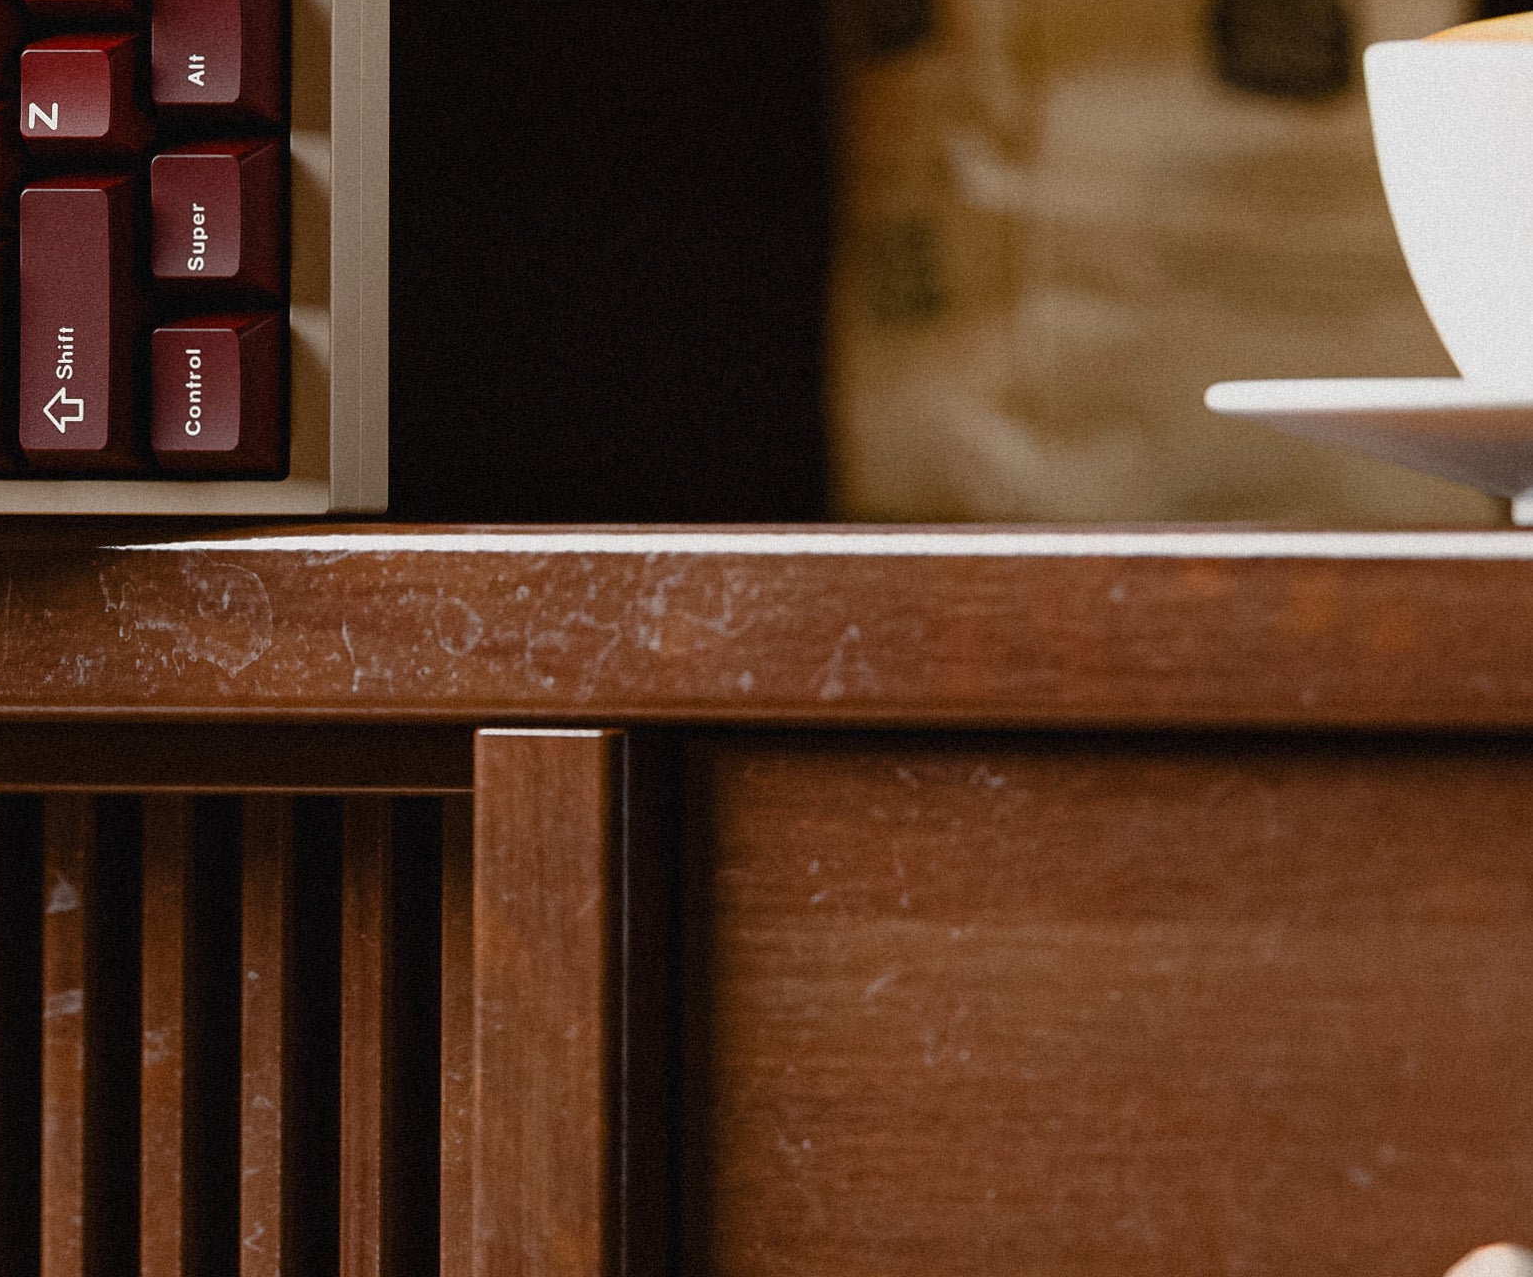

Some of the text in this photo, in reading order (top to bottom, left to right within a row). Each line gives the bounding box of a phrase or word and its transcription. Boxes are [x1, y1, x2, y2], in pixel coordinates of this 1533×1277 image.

[187, 54, 205, 87] Alt
[28, 102, 59, 131] Z
[187, 203, 209, 271] Super
[55, 326, 74, 380] Shift
[184, 349, 202, 437] Control
